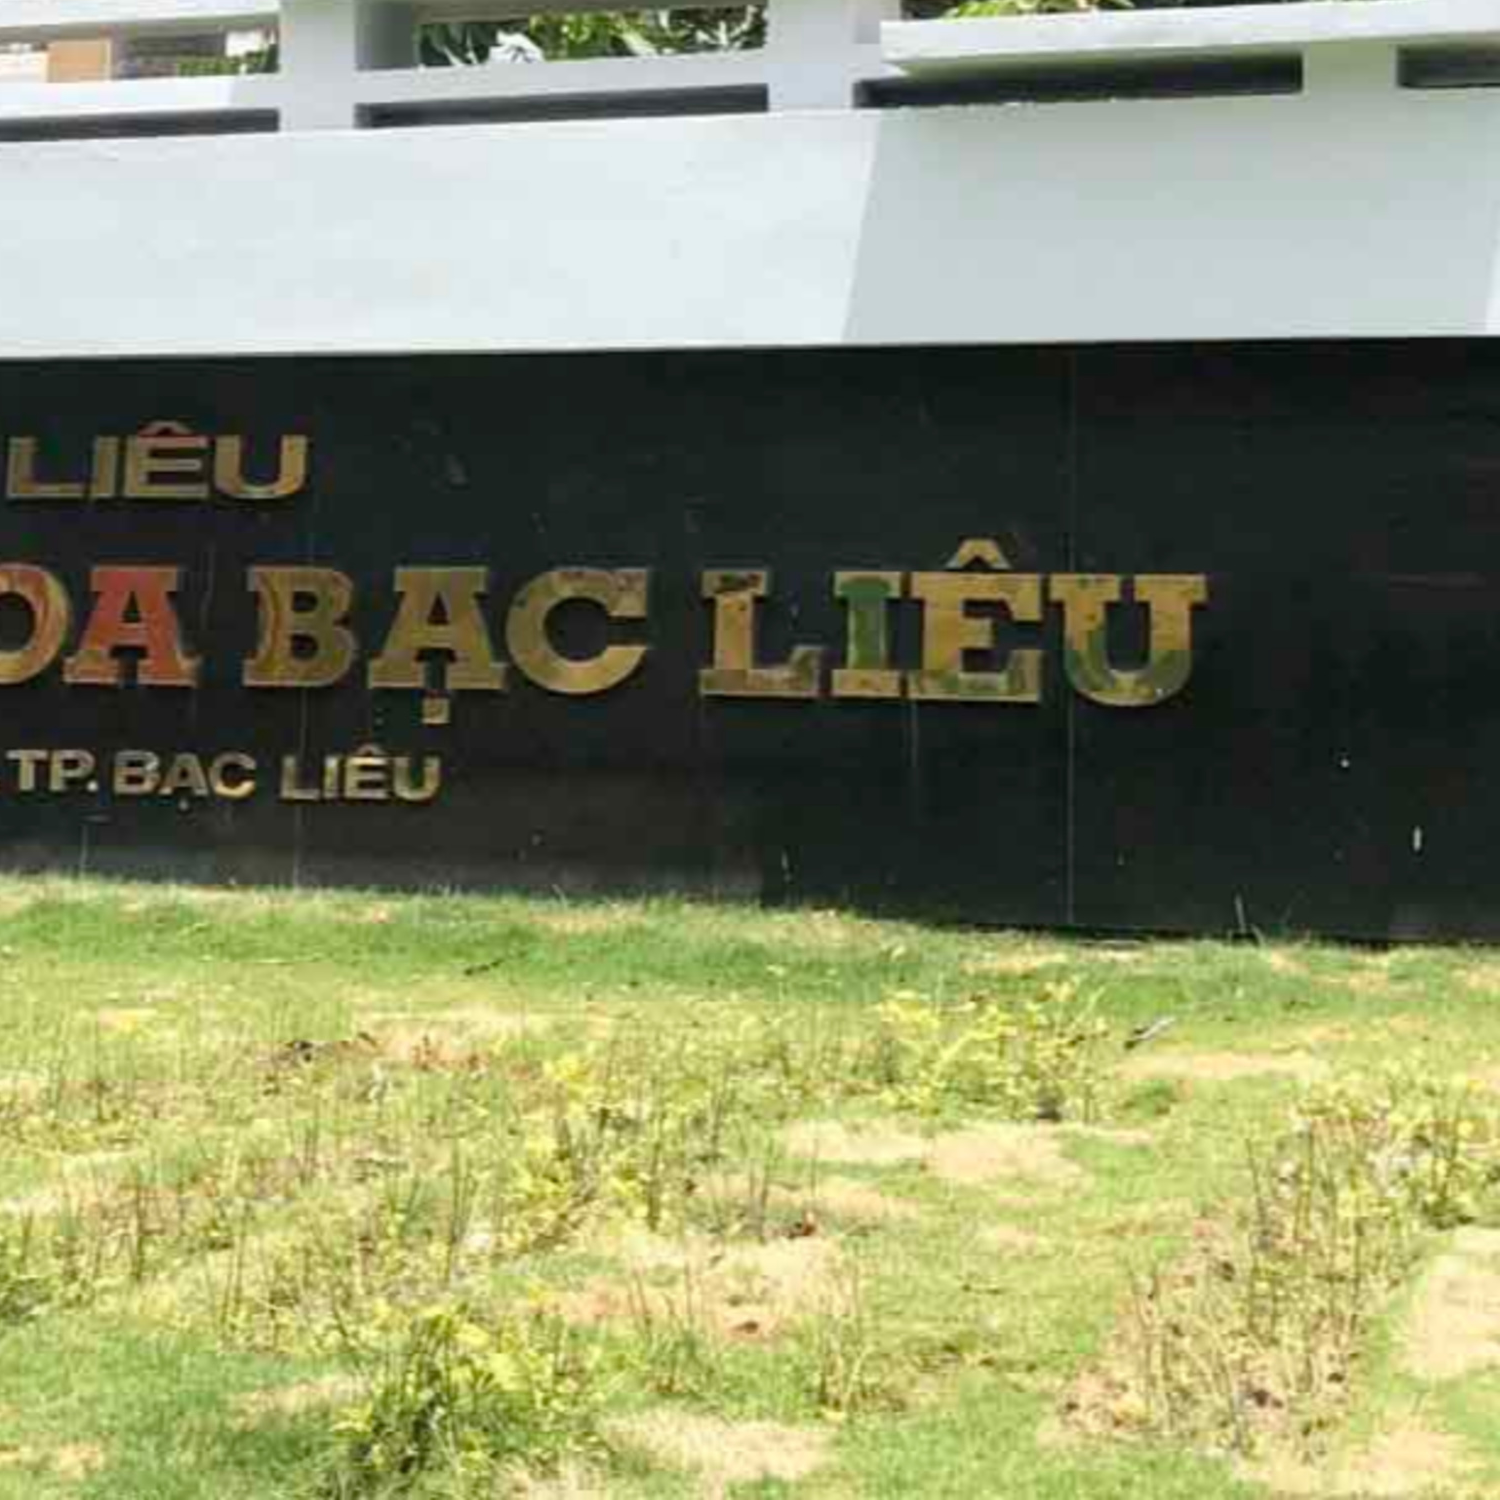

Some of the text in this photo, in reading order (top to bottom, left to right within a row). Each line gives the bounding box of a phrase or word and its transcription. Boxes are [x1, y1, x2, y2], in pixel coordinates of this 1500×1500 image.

[5, 419, 309, 500] LIÊU
[242, 565, 649, 724] BẠC
[699, 538, 1208, 706] LIÊU
[6, 749, 99, 792] TP.
[113, 749, 257, 811] BẠC
[280, 742, 442, 801] LIÊU
